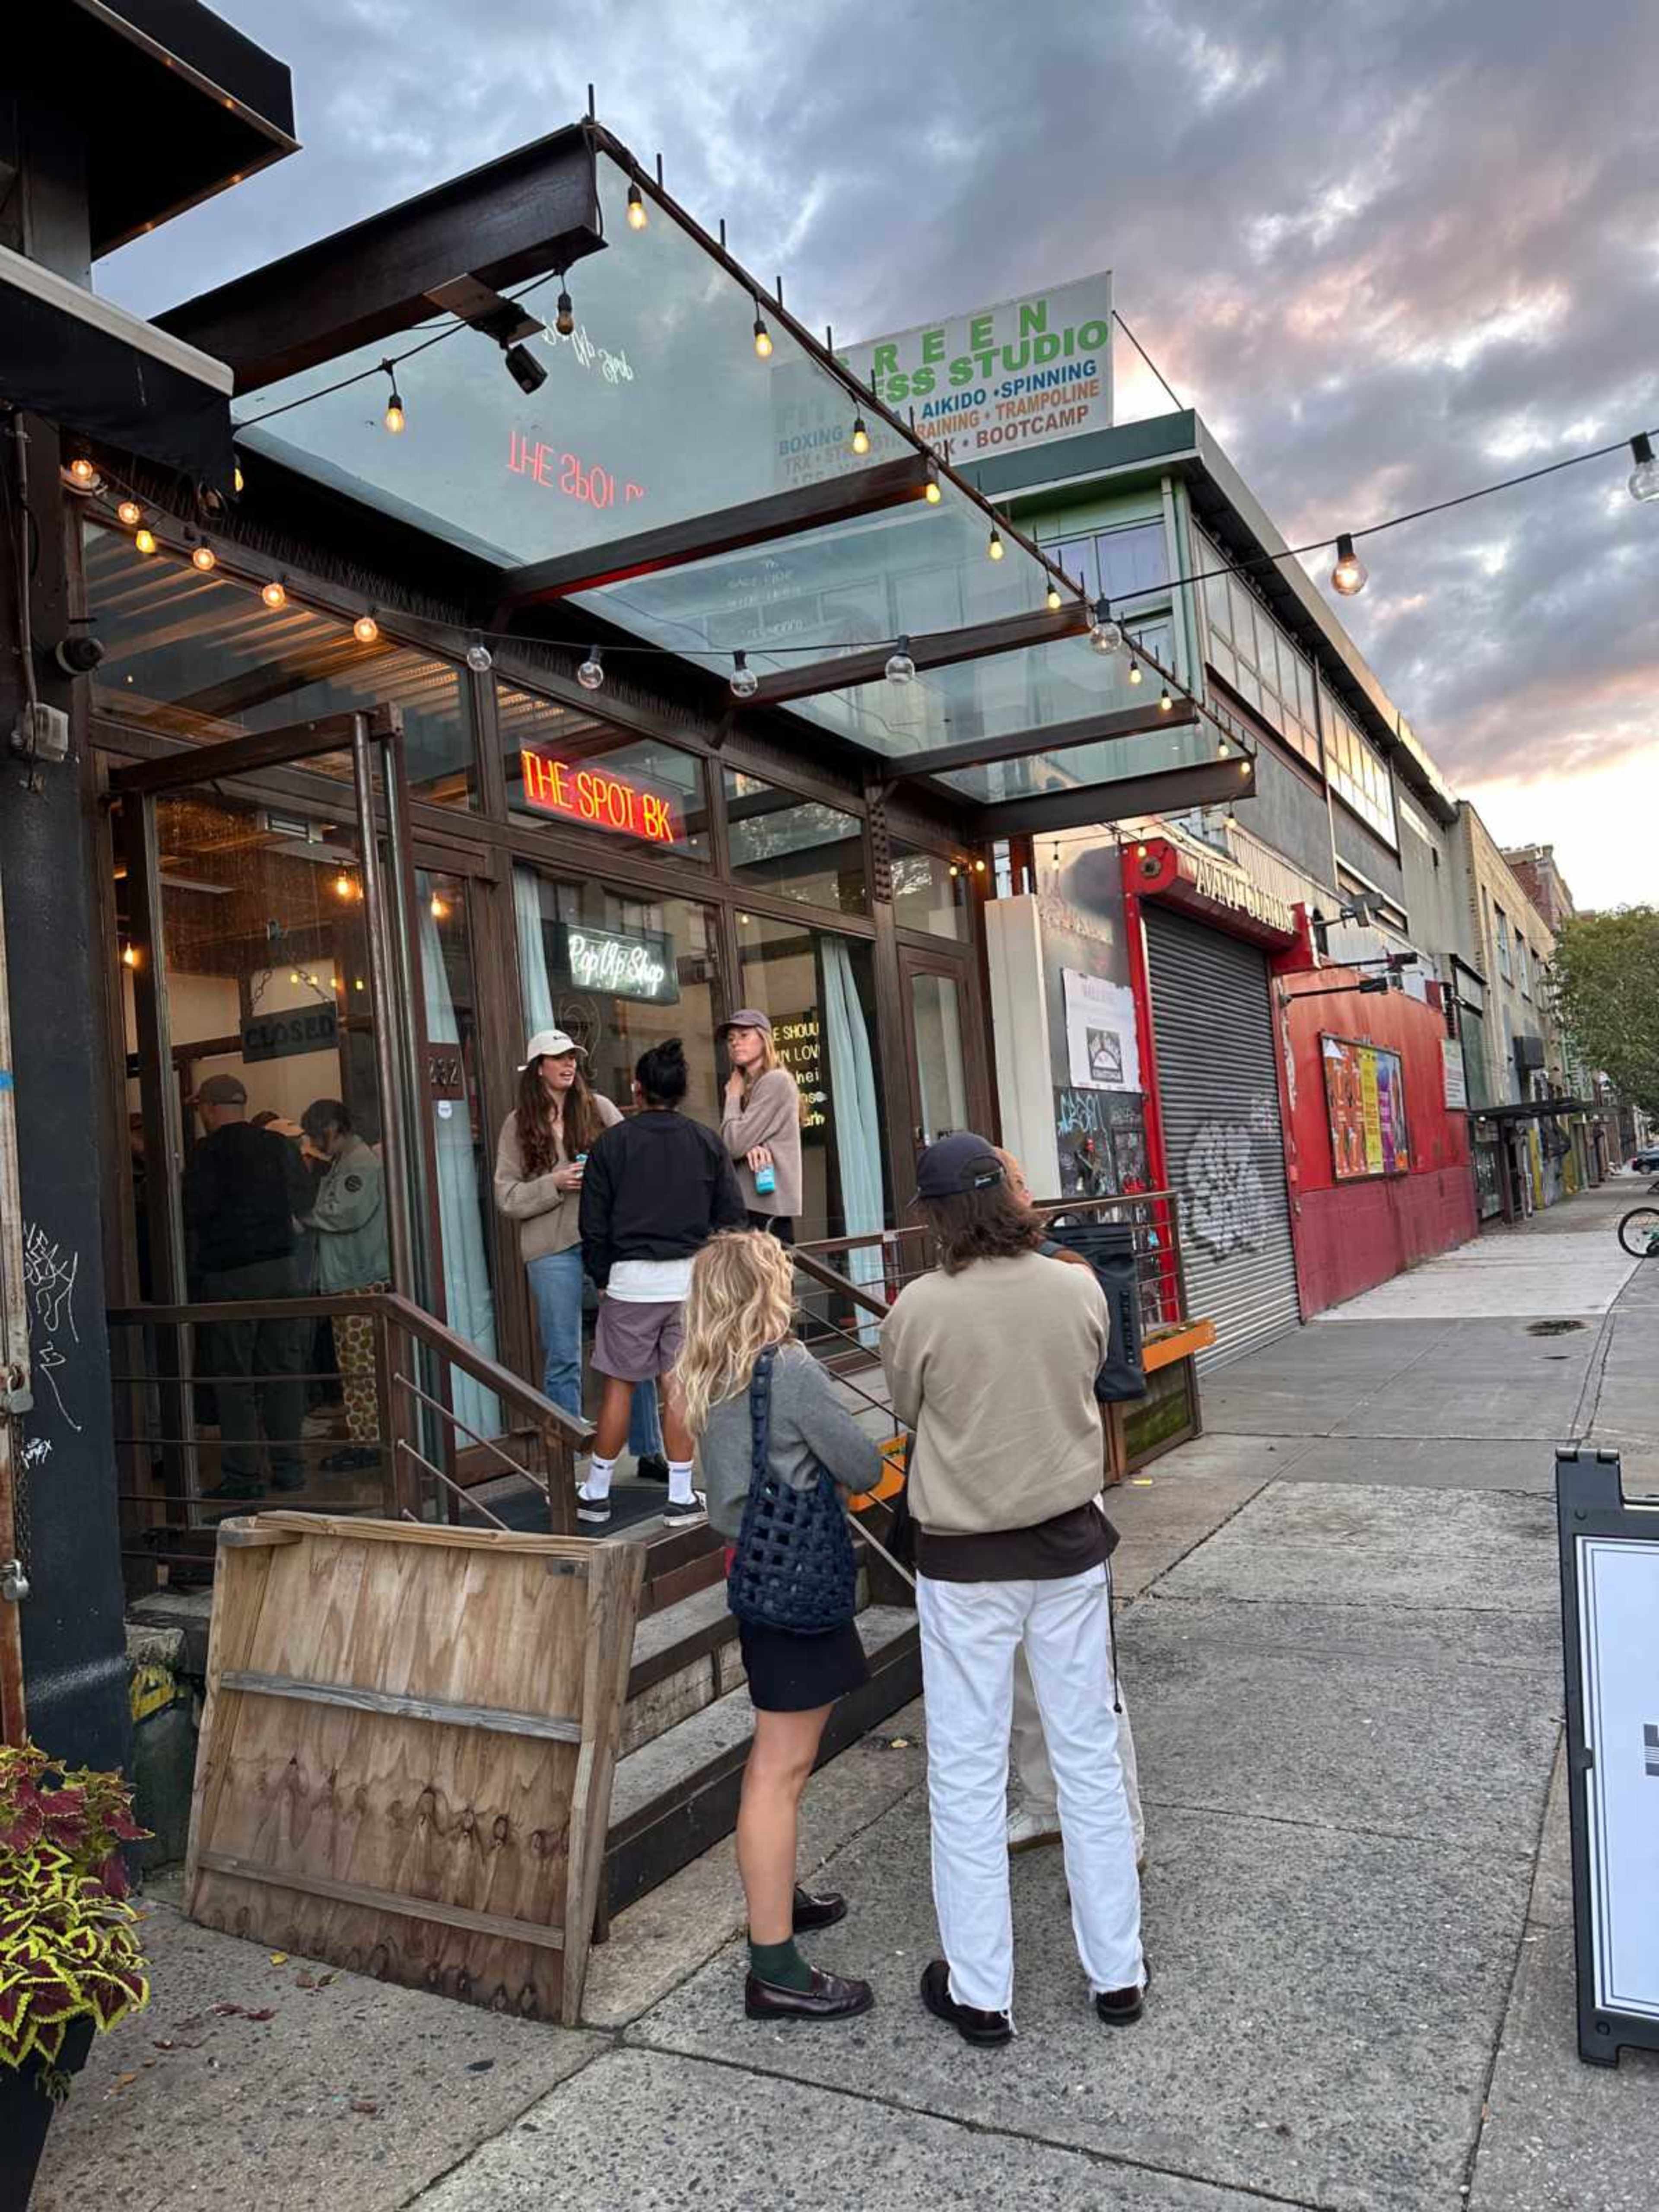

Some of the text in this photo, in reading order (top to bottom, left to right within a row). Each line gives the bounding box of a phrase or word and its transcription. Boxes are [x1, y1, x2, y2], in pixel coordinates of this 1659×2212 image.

[837, 299, 1047, 377] REEN
[949, 320, 1108, 387] STUDIO
[779, 426, 842, 454] BOXING
[922, 388, 986, 419] AIKIDO
[1001, 359, 1096, 398] SPINNING
[917, 410, 980, 441] RAINING
[995, 378, 1100, 421] TRAMPOLINE
[976, 405, 1089, 448] BOOTCAMP
[521, 749, 674, 843] THE SPOT BK
[568, 934, 664, 996] Pop Up Shop
[246, 1015, 334, 1049] CLOSED
